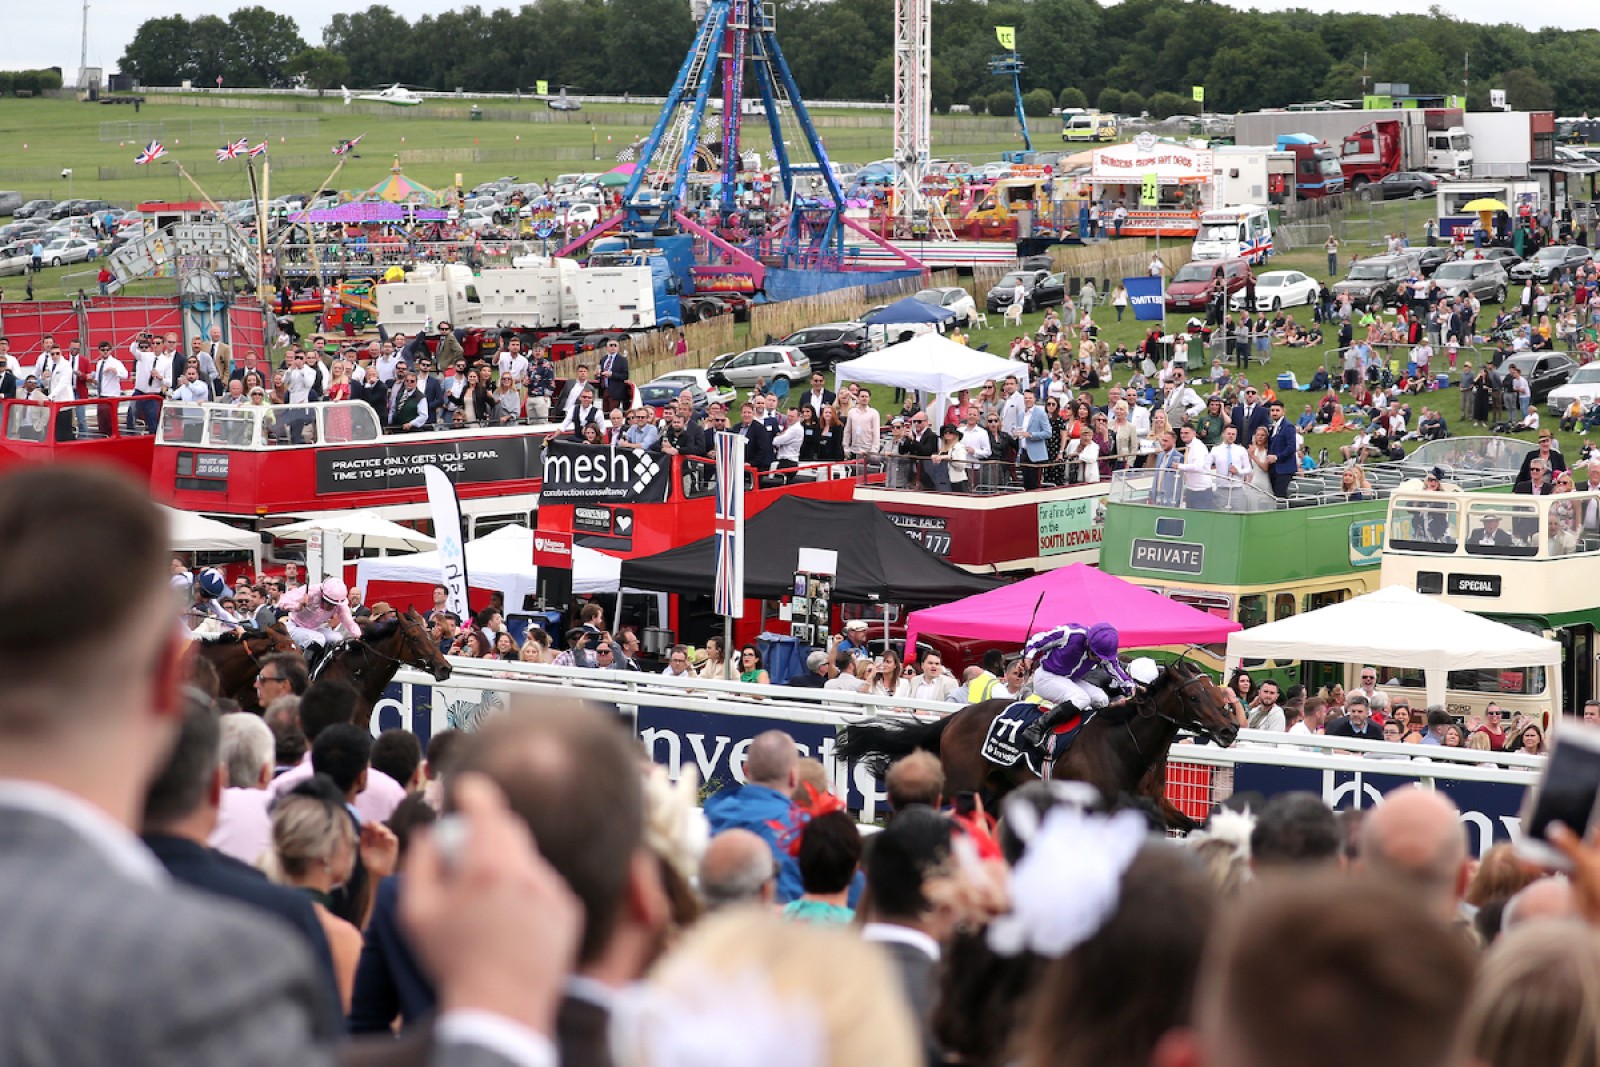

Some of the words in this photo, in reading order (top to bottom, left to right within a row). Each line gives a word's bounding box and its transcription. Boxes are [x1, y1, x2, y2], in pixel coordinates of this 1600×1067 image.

[332, 458, 381, 470] PRACTICE
[383, 456, 410, 465] ONLY
[411, 454, 437, 464] GETS
[439, 452, 461, 463] YOU
[462, 451, 476, 461] SO
[543, 446, 629, 483] mesh
[332, 470, 357, 481] TIME
[359, 470, 373, 479] TO
[374, 467, 406, 478] SHOW
[543, 488, 585, 497] construction
[585, 487, 628, 497] consultancy
[926, 535, 951, 554] 777
[1040, 533, 1065, 549] SOUTH
[1066, 529, 1091, 547] DEVON
[1137, 546, 1200, 565] PRIVATE
[1459, 580, 1493, 592] SPECIAL
